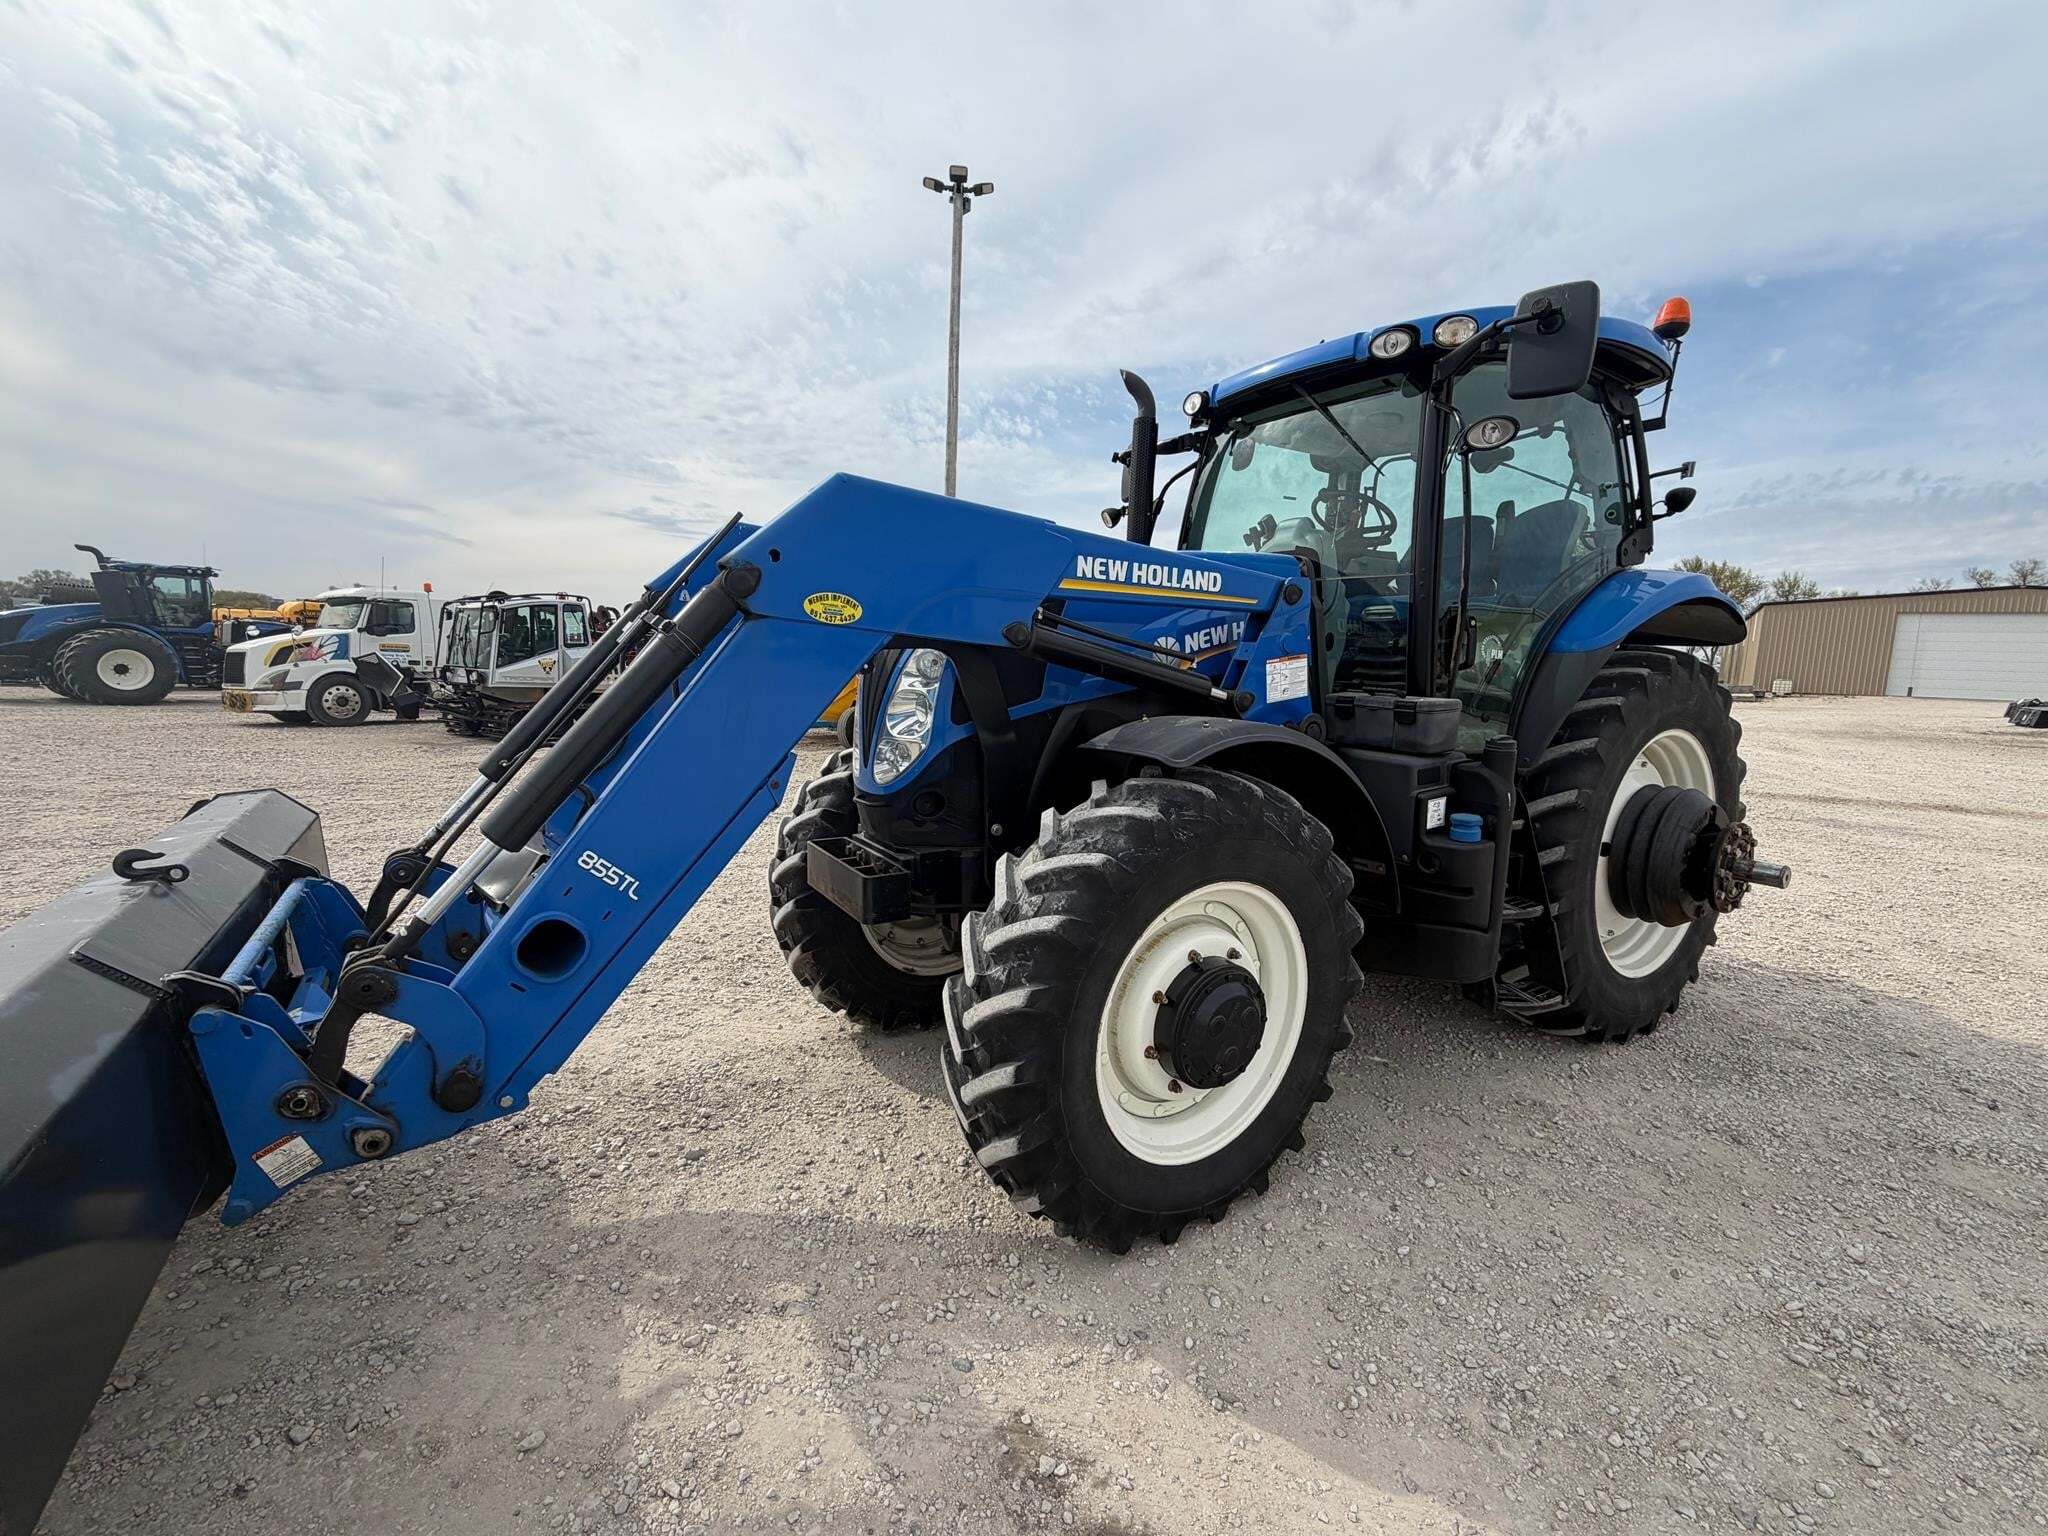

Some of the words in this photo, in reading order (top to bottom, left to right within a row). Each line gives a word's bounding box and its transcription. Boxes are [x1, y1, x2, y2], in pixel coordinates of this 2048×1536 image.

[1076, 555, 1129, 582] NEW
[1132, 562, 1222, 593] HOLLAND
[1184, 624, 1228, 653] NEW
[577, 850, 640, 900] 855TL
